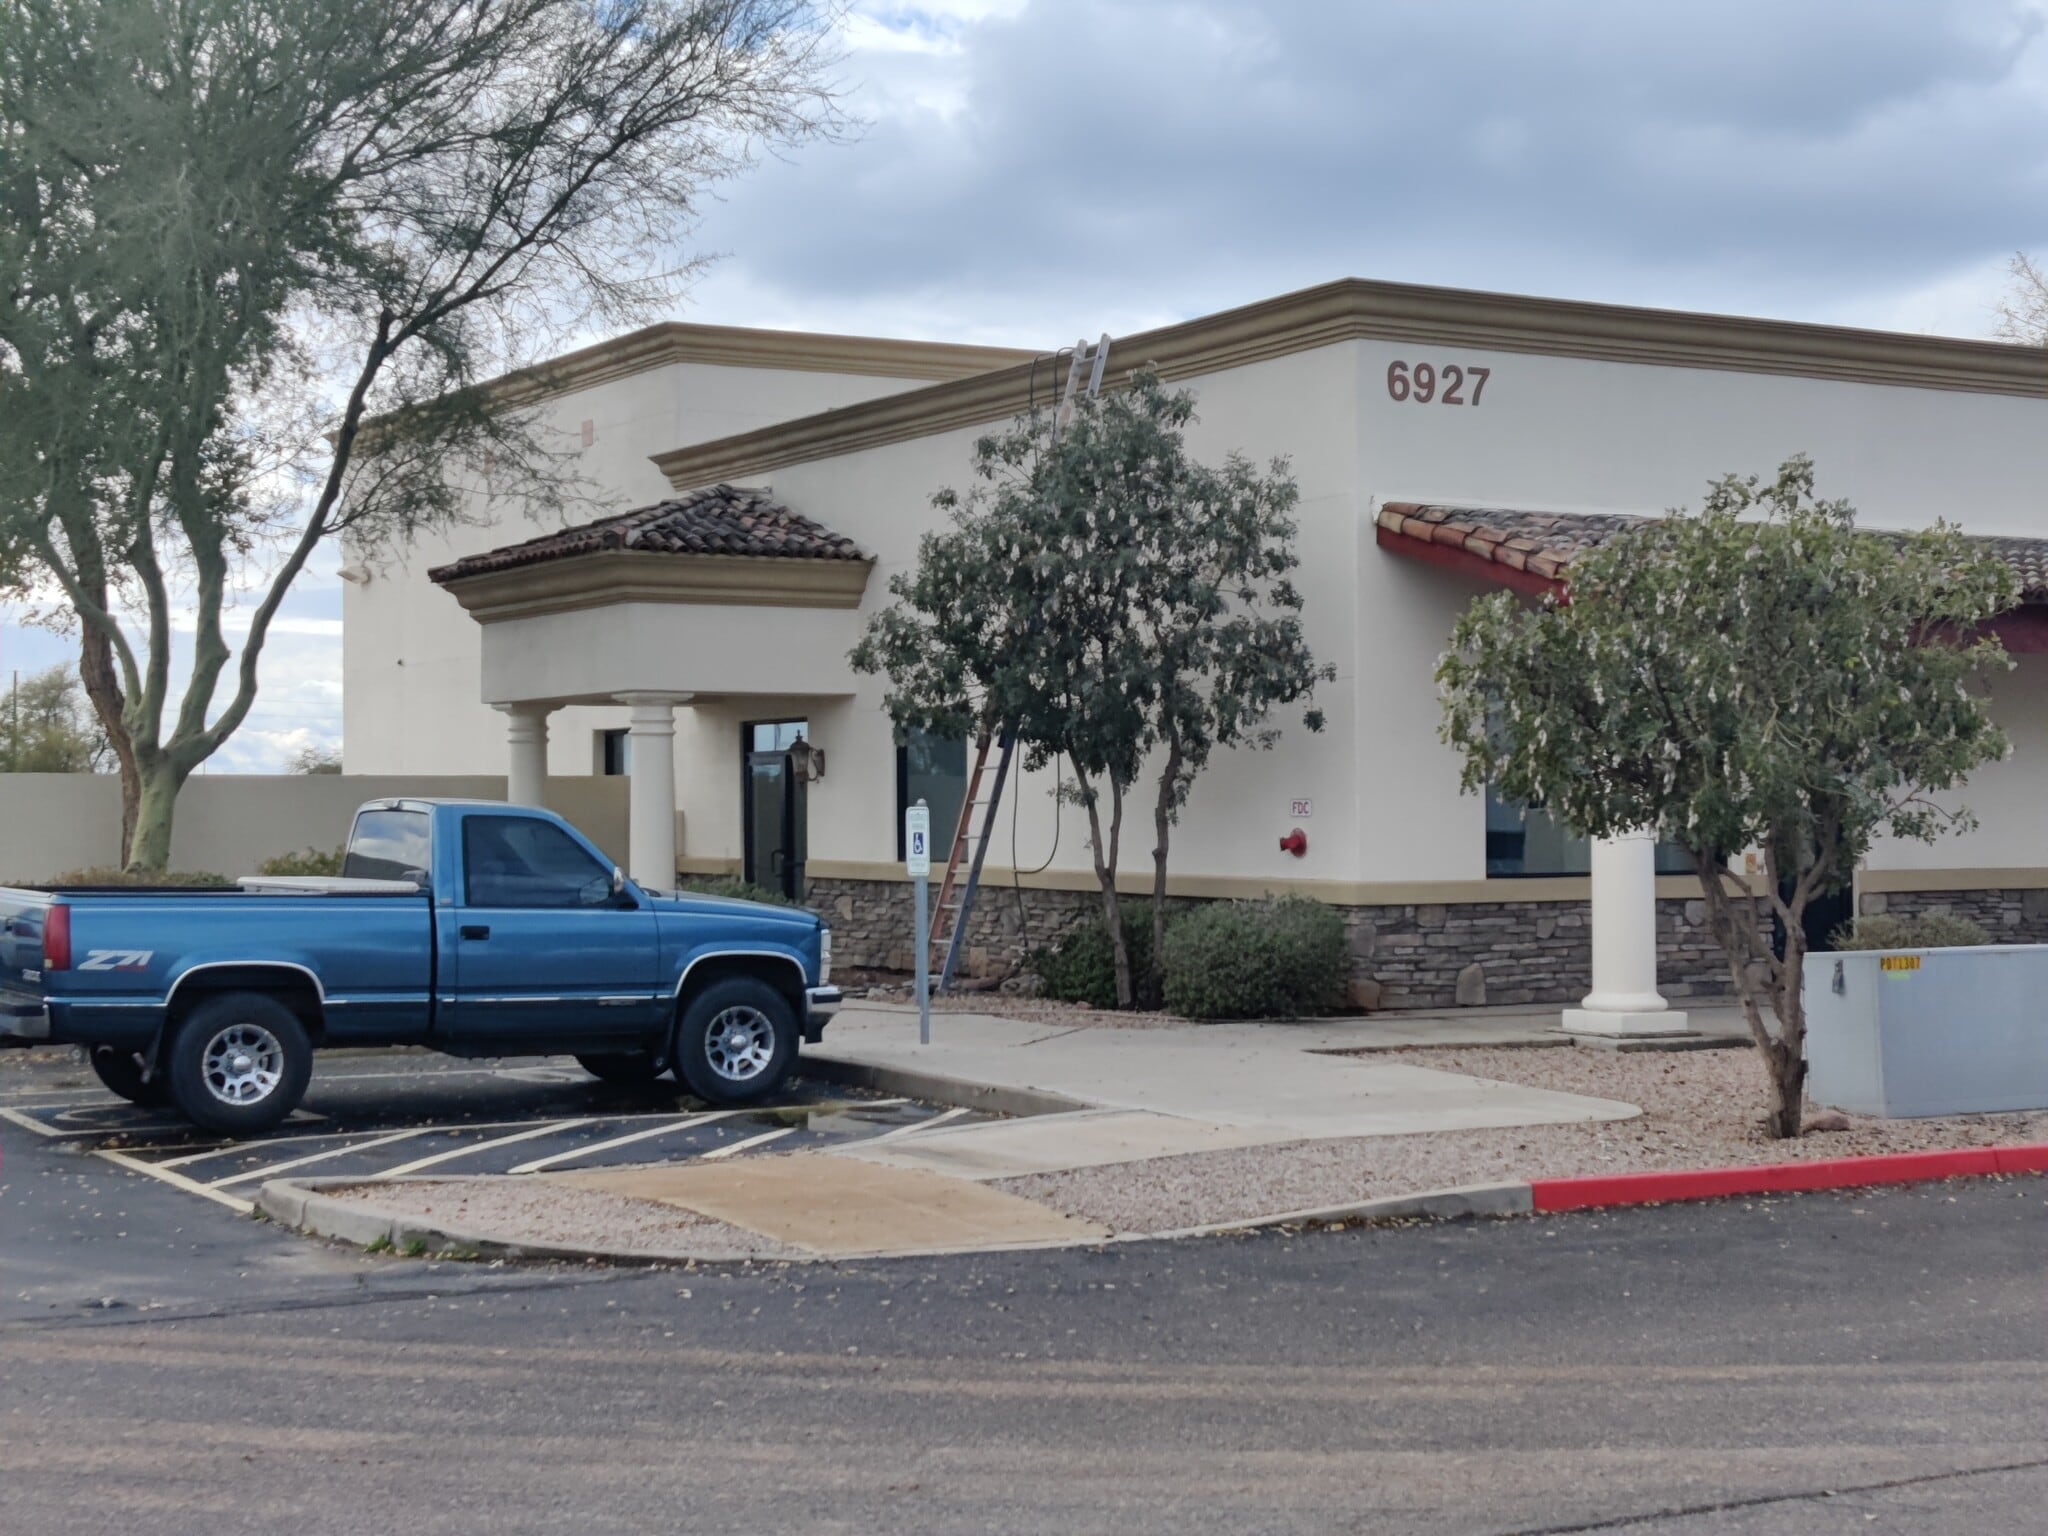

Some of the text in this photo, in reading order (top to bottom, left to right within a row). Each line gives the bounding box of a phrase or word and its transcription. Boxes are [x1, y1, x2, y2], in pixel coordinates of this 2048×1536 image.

[1387, 360, 1491, 407] 6927
[1292, 801, 1309, 815] FDC
[77, 950, 154, 970] Z71
